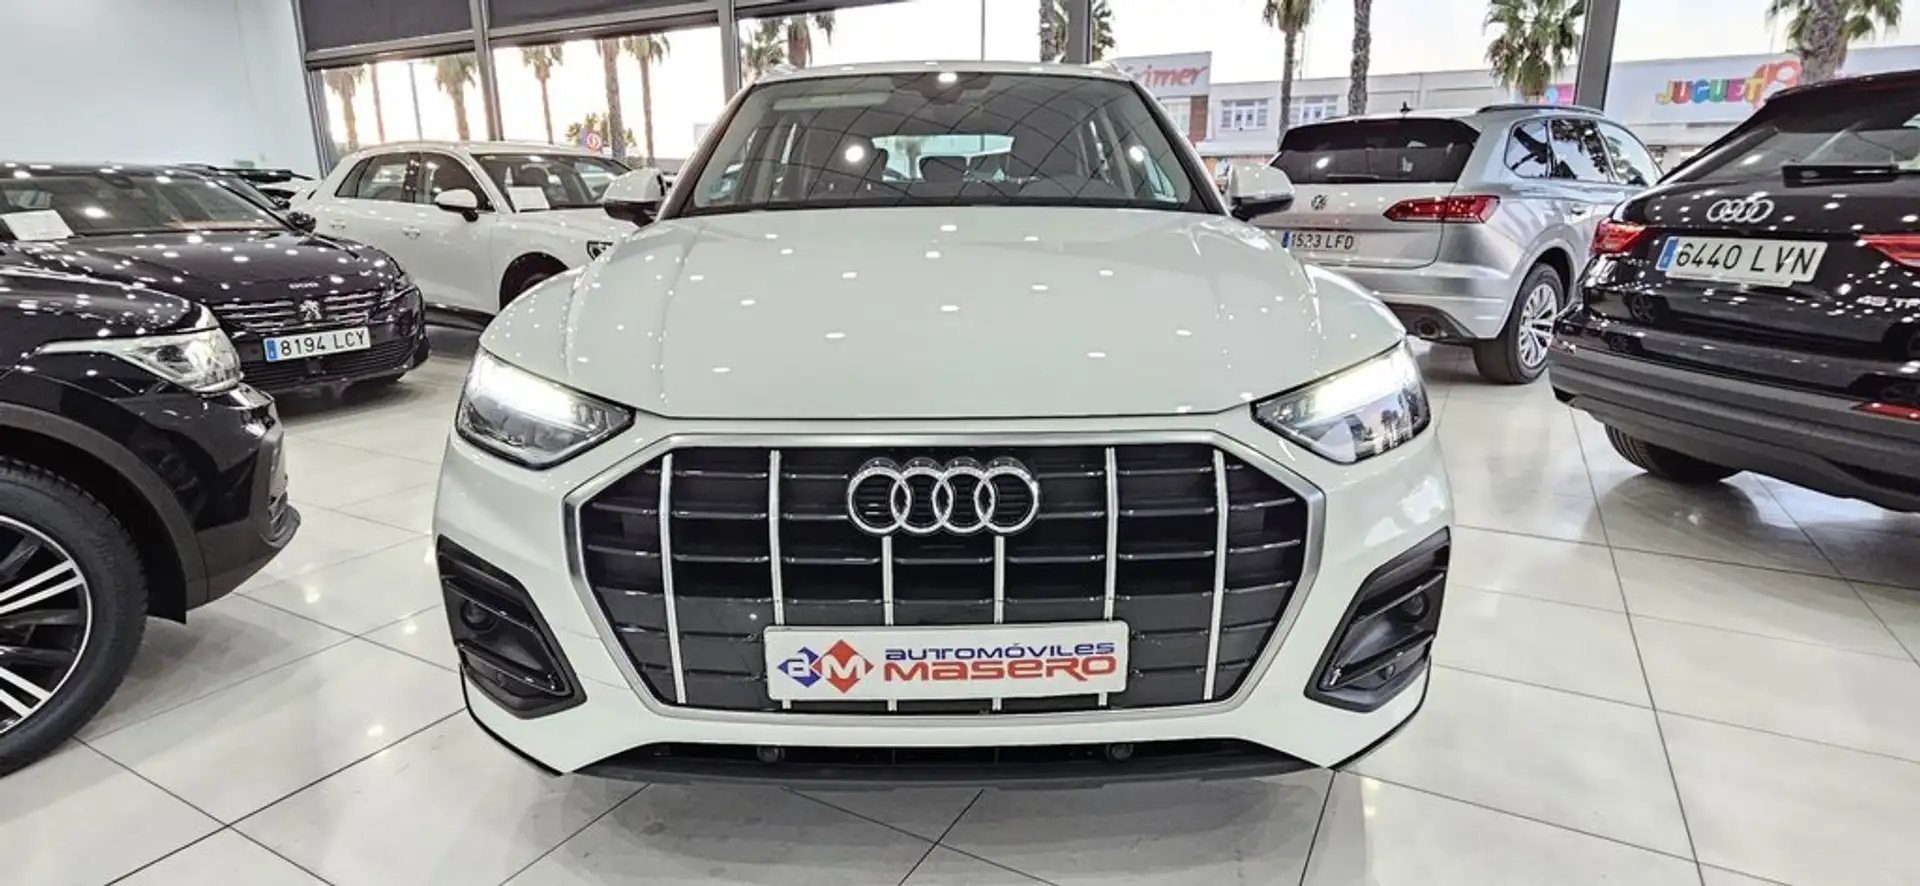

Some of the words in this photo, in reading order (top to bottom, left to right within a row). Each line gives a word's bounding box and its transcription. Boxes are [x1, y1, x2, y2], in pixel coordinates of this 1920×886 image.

[1676, 243, 1742, 269] 6440
[1750, 245, 1817, 275] LVN
[280, 336, 326, 356] 8194
[333, 330, 366, 349] LCY
